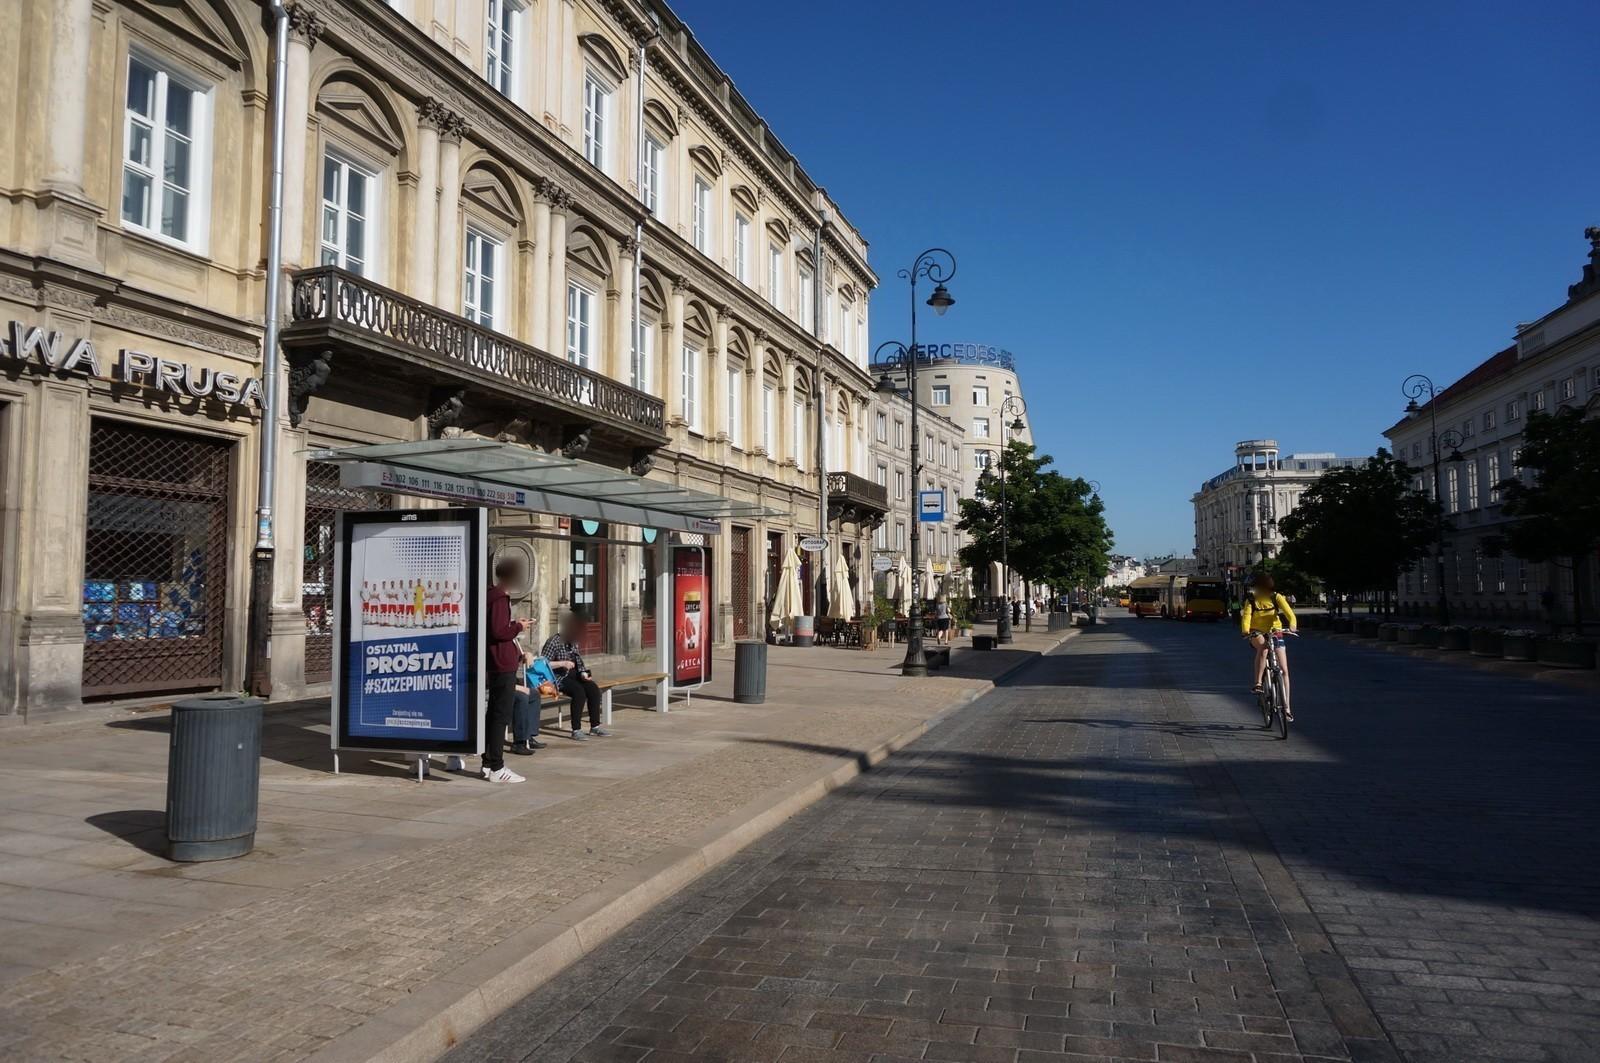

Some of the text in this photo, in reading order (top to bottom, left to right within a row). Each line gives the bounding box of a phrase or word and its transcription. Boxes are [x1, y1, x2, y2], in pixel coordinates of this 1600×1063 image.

[120, 349, 268, 410] PRUSA
[383, 471, 393, 482] E-2
[421, 479, 430, 488] 111
[433, 481, 443, 490] 116
[456, 484, 465, 494] 175
[487, 489, 496, 499] 222
[366, 643, 419, 655] OSTATNIA
[366, 651, 454, 675] PROSTA!
[364, 673, 453, 695] #SZCZEPIMYSIĘ
